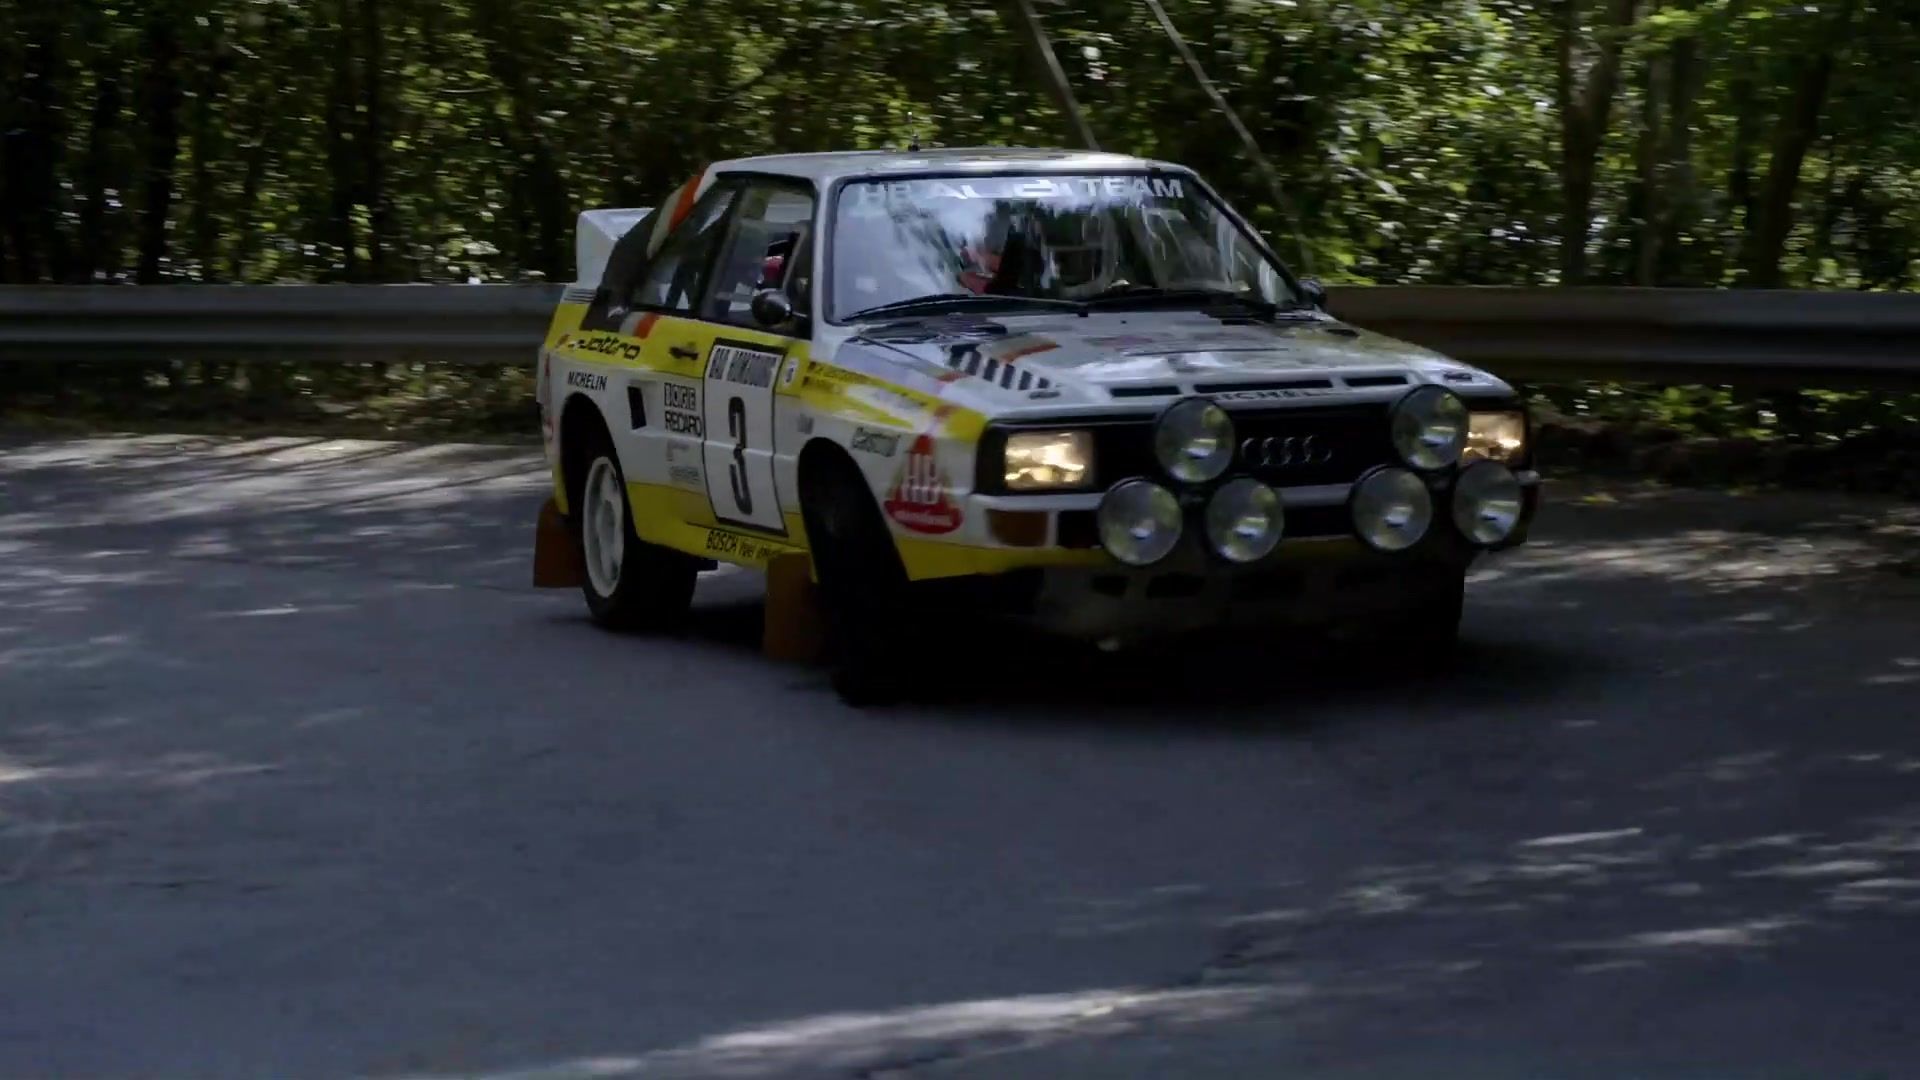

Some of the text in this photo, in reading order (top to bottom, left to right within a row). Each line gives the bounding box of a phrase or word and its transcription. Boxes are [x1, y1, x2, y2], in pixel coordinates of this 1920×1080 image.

[1078, 176, 1184, 199] TEAM
[568, 371, 608, 390] MICHELIN
[665, 411, 703, 437] RECARO
[729, 396, 753, 515] 3
